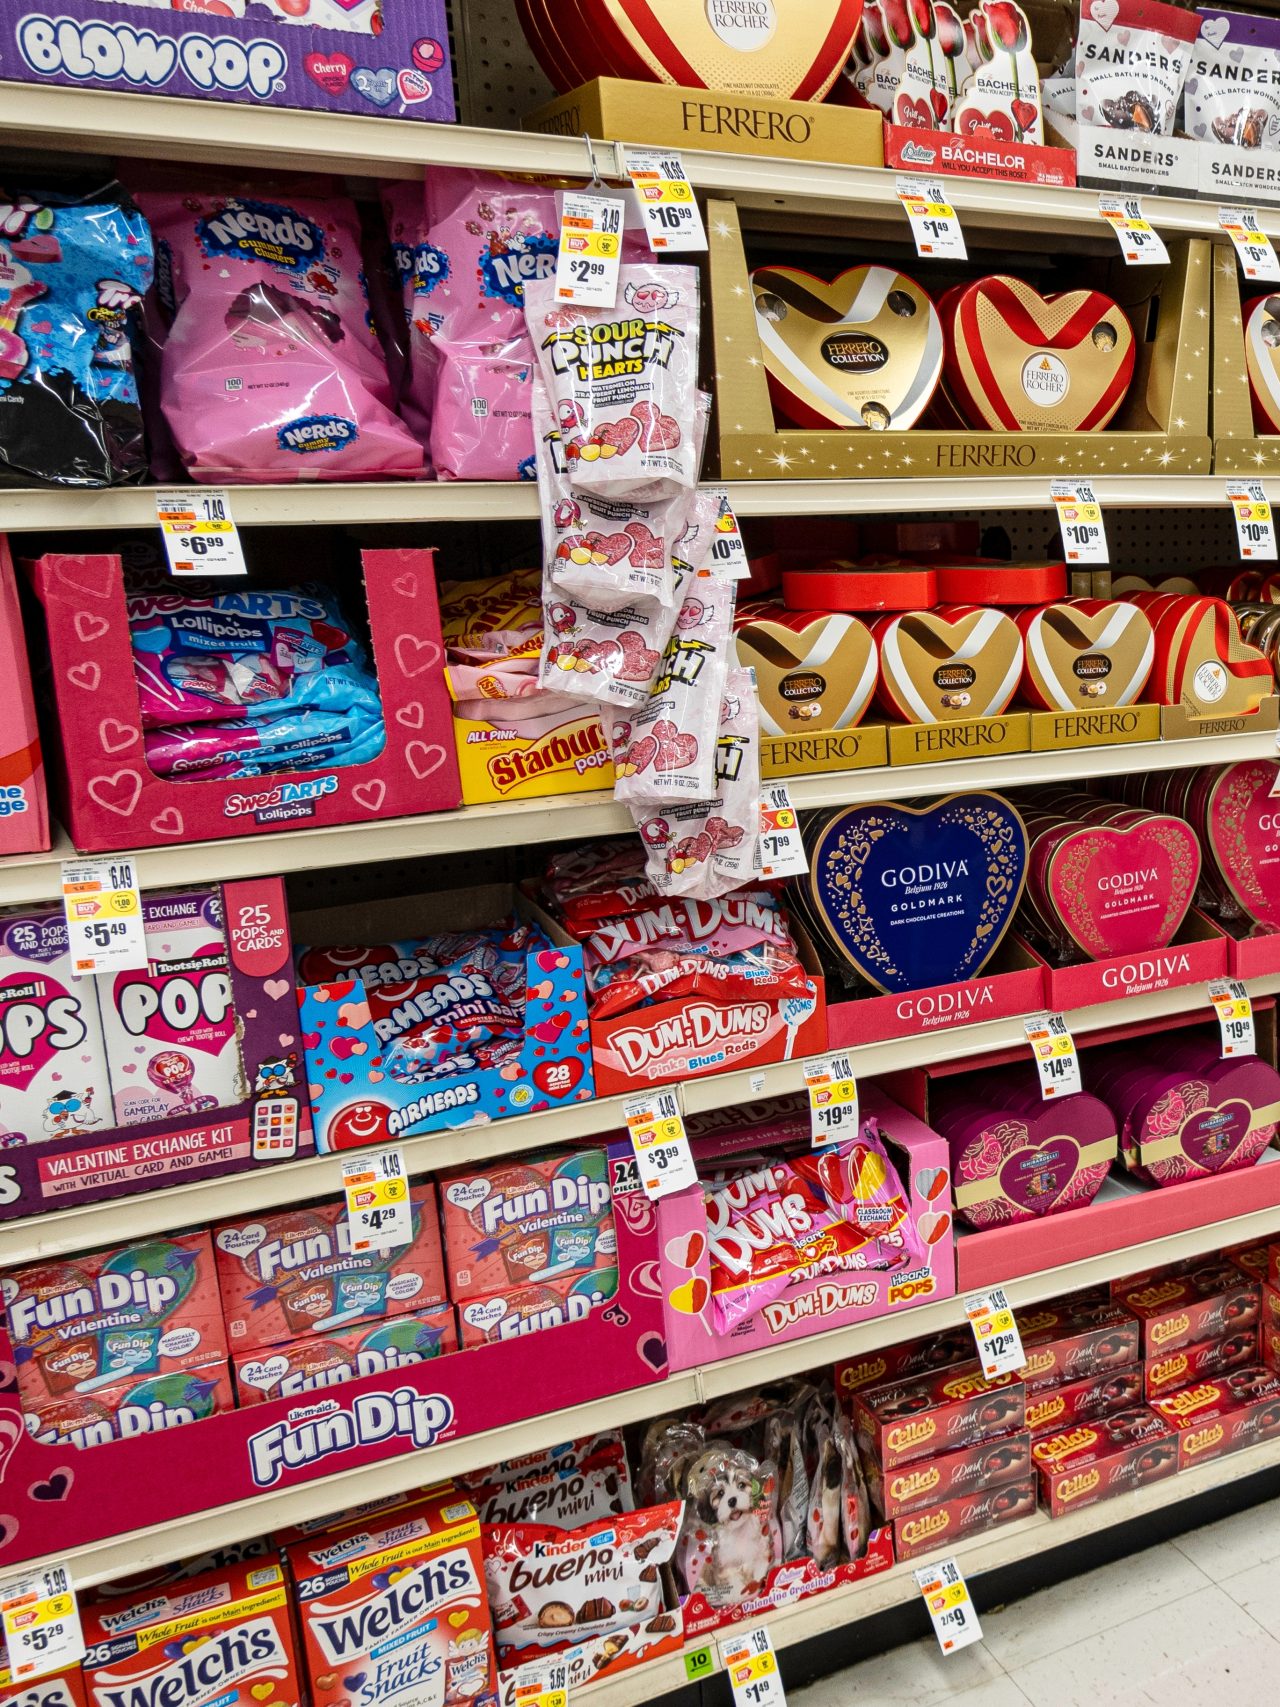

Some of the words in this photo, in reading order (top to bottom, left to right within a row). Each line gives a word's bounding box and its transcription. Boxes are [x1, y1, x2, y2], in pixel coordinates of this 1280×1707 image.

[713, 13, 770, 29] ROCHER
[16, 13, 178, 86] BLOW
[180, 32, 288, 99] POP
[1085, 44, 1183, 74] SANDERS
[312, 61, 348, 78] Cherry
[682, 101, 810, 144] FERRERO
[942, 146, 1025, 170] BACHELOR
[1095, 144, 1174, 167] SANDERS
[941, 162, 956, 172] WILL
[957, 164, 973, 174] YOU
[973, 166, 996, 176] ACCEPT
[996, 169, 1009, 178] THIS
[1009, 170, 1028, 180] ROSE?
[238, 238, 284, 256] Gummy
[255, 247, 295, 266] Clusters
[574, 319, 645, 345] SOUR
[551, 332, 677, 375] PUNCH
[827, 341, 882, 356] FERRERO
[831, 352, 886, 365] COLLECTION
[578, 360, 644, 382] HEARTS
[1026, 371, 1064, 383] FERRERO
[591, 379, 636, 393] WATERMELON
[1026, 379, 1064, 394] ROCHER
[592, 396, 614, 408] FRUIT
[613, 392, 637, 405] PUNCH
[936, 444, 1036, 467] FERRERO
[172, 615, 263, 639] Lollipops
[188, 636, 226, 648] mixed
[230, 639, 259, 649] fruit
[784, 685, 823, 697] COLLECTION
[915, 722, 1006, 751] FERRERO
[1054, 711, 1138, 739] FERRERO
[259, 805, 312, 821] Lollipops
[881, 861, 969, 888] GODIVA
[1098, 868, 1158, 891] GODIVA
[149, 902, 198, 918] EXCHANGE
[891, 894, 963, 913] GOLDMARK
[1104, 894, 1155, 910] GOLDMARK
[239, 904, 270, 925] 25
[890, 918, 905, 926] DARK
[905, 913, 937, 923] CHOCOLATE
[938, 910, 964, 919] CREATIONS
[13, 926, 35, 941] 25
[20, 939, 38, 949] AND
[237, 936, 282, 952] CARDS
[436, 1001, 487, 1026] mini
[896, 986, 993, 1020] GODIVA
[922, 1014, 951, 1027] Belgium
[953, 1010, 970, 1020] 1926
[647, 1058, 686, 1080] Pinks
[688, 1052, 725, 1070] Blues
[725, 1039, 757, 1056] Reds
[546, 1065, 571, 1081] 28
[387, 1083, 479, 1135] AIRHEADS
[48, 1147, 130, 1176] VALENTINE
[134, 1131, 205, 1159] EXCHANGE
[211, 1126, 233, 1143] KIT
[53, 1180, 76, 1192] WITH
[80, 1168, 131, 1186] VIRTUAL
[134, 1161, 165, 1177] CARD
[170, 1156, 194, 1171] AND
[198, 1147, 233, 1163] GAME!
[482, 1187, 550, 1235] Fun
[552, 1174, 612, 1218] Dip
[856, 1207, 893, 1219] CLASSROOM
[519, 1212, 584, 1235] Valentine
[891, 1268, 930, 1286] Heart
[8, 1286, 95, 1345] Fun
[98, 1271, 178, 1315] Dip
[57, 1312, 141, 1340] Valentine
[249, 1409, 355, 1488] Fun
[352, 1385, 455, 1448] Dip
[1032, 1427, 1098, 1461] Cella's
[535, 1540, 586, 1558] Kinder
[509, 1547, 614, 1594] bueno
[584, 1565, 624, 1587] mini
[743, 1586, 789, 1613] Valentine
[789, 1574, 835, 1600] Greetings
[319, 1557, 471, 1656] Welch's
[139, 1626, 171, 1644] Whole
[174, 1617, 199, 1633] Fruit
[208, 1614, 221, 1622] our
[222, 1607, 241, 1618] Main
[377, 1634, 409, 1654] MIXED
[409, 1622, 432, 1640] FRUIT
[375, 1642, 430, 1679] Fruit
[690, 1653, 707, 1669] 10
[360, 1656, 443, 1705] Snacks
